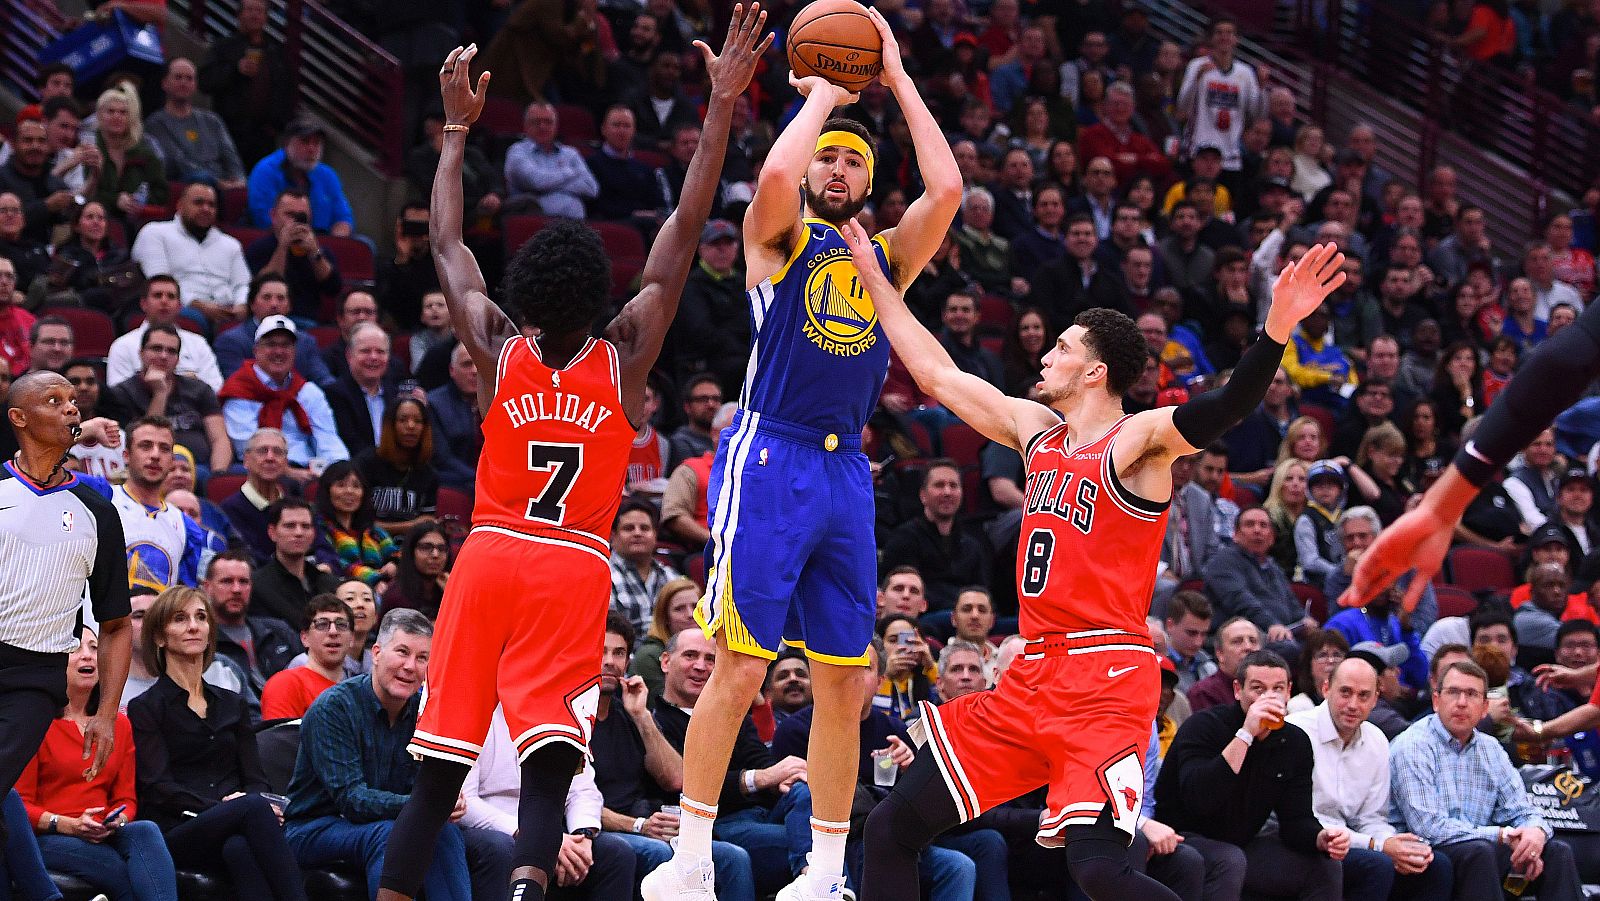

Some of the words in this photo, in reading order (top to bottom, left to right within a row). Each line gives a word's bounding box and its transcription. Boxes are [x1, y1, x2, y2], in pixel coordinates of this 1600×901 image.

[850, 275, 864, 300] 11
[801, 320, 877, 357] WARRIORS
[502, 392, 613, 434] HOLIDAY
[524, 440, 584, 527] 7
[1021, 528, 1056, 597] 8
[1532, 782, 1557, 796] Old
